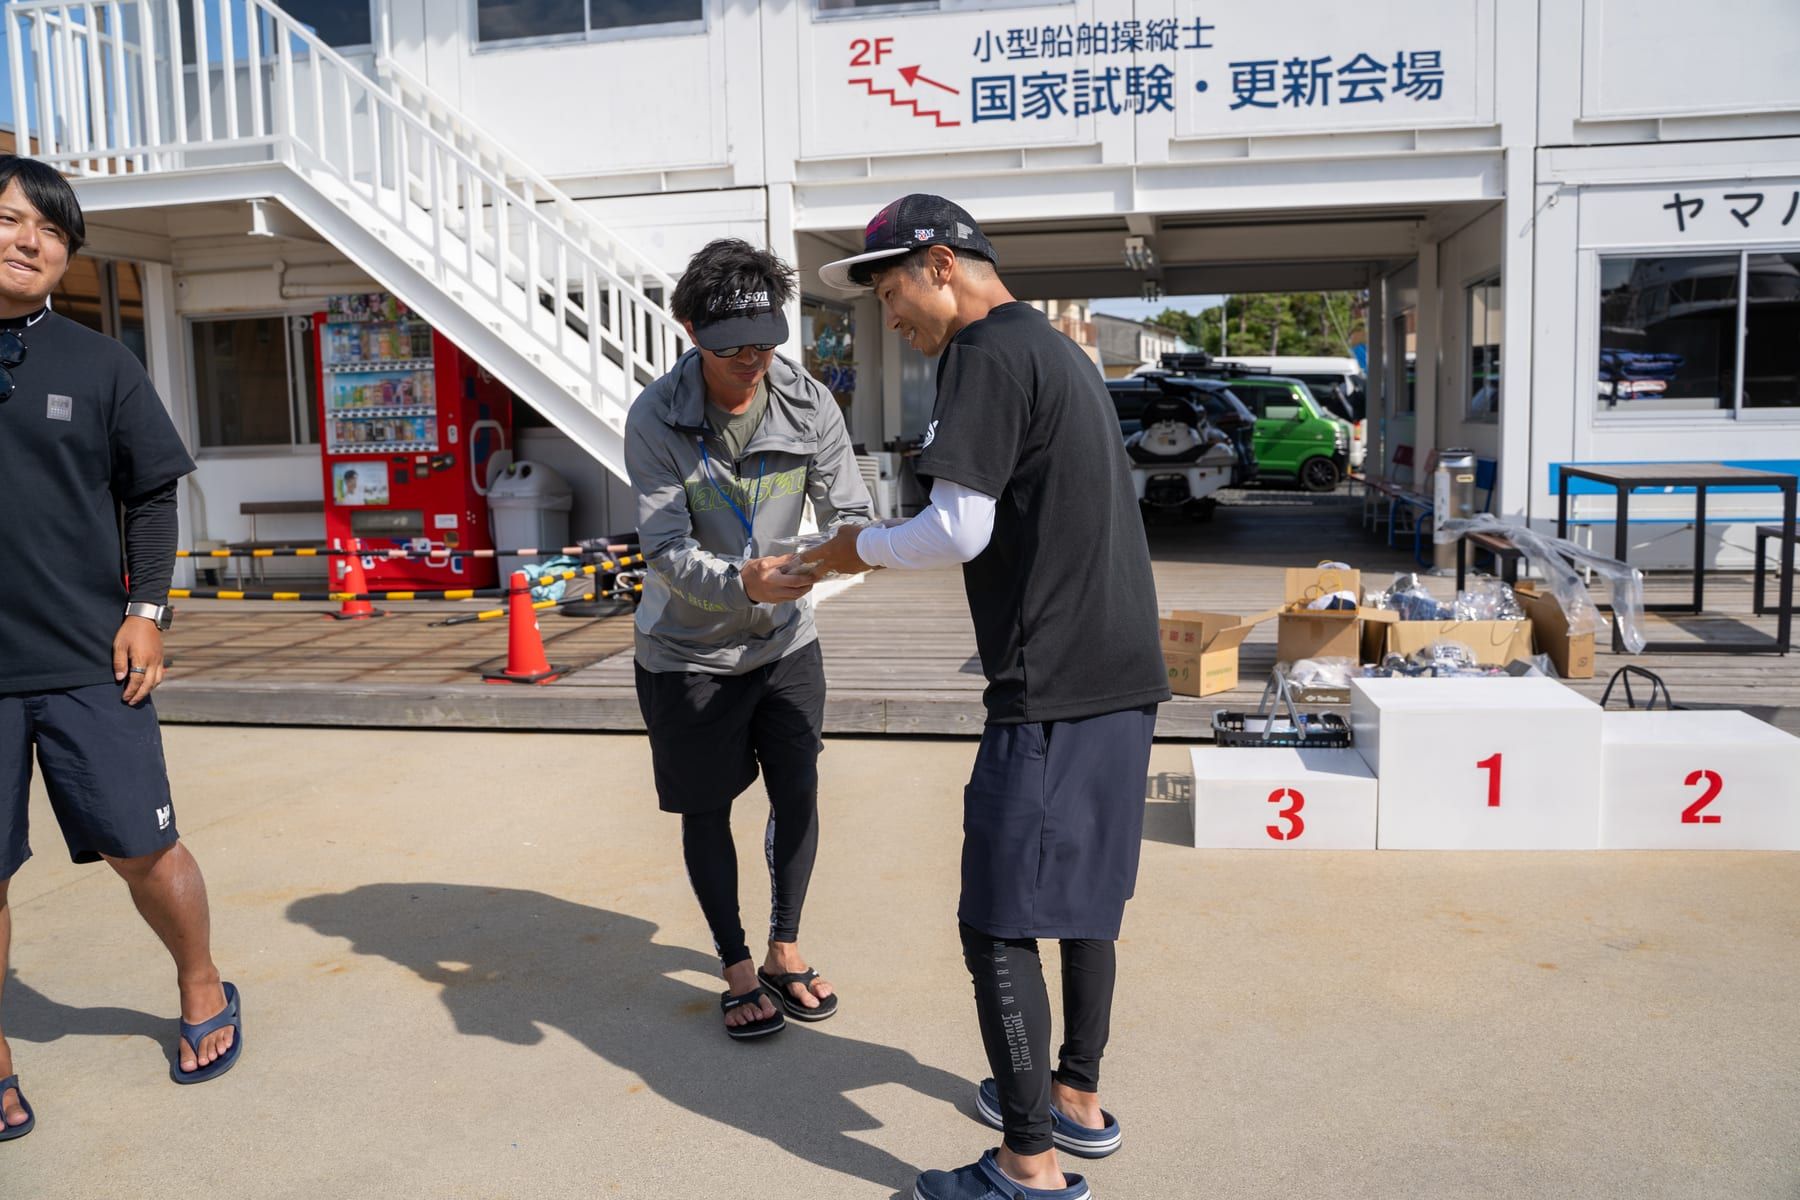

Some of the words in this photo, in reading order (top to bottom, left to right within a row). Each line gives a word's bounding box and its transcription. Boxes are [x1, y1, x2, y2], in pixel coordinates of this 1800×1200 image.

[850, 37, 894, 66] 2F
[973, 17, 1215, 63] 小型船舶操縦士
[1476, 753, 1502, 807] 1
[1681, 769, 1723, 823] 2
[1266, 788, 1305, 841] 3
